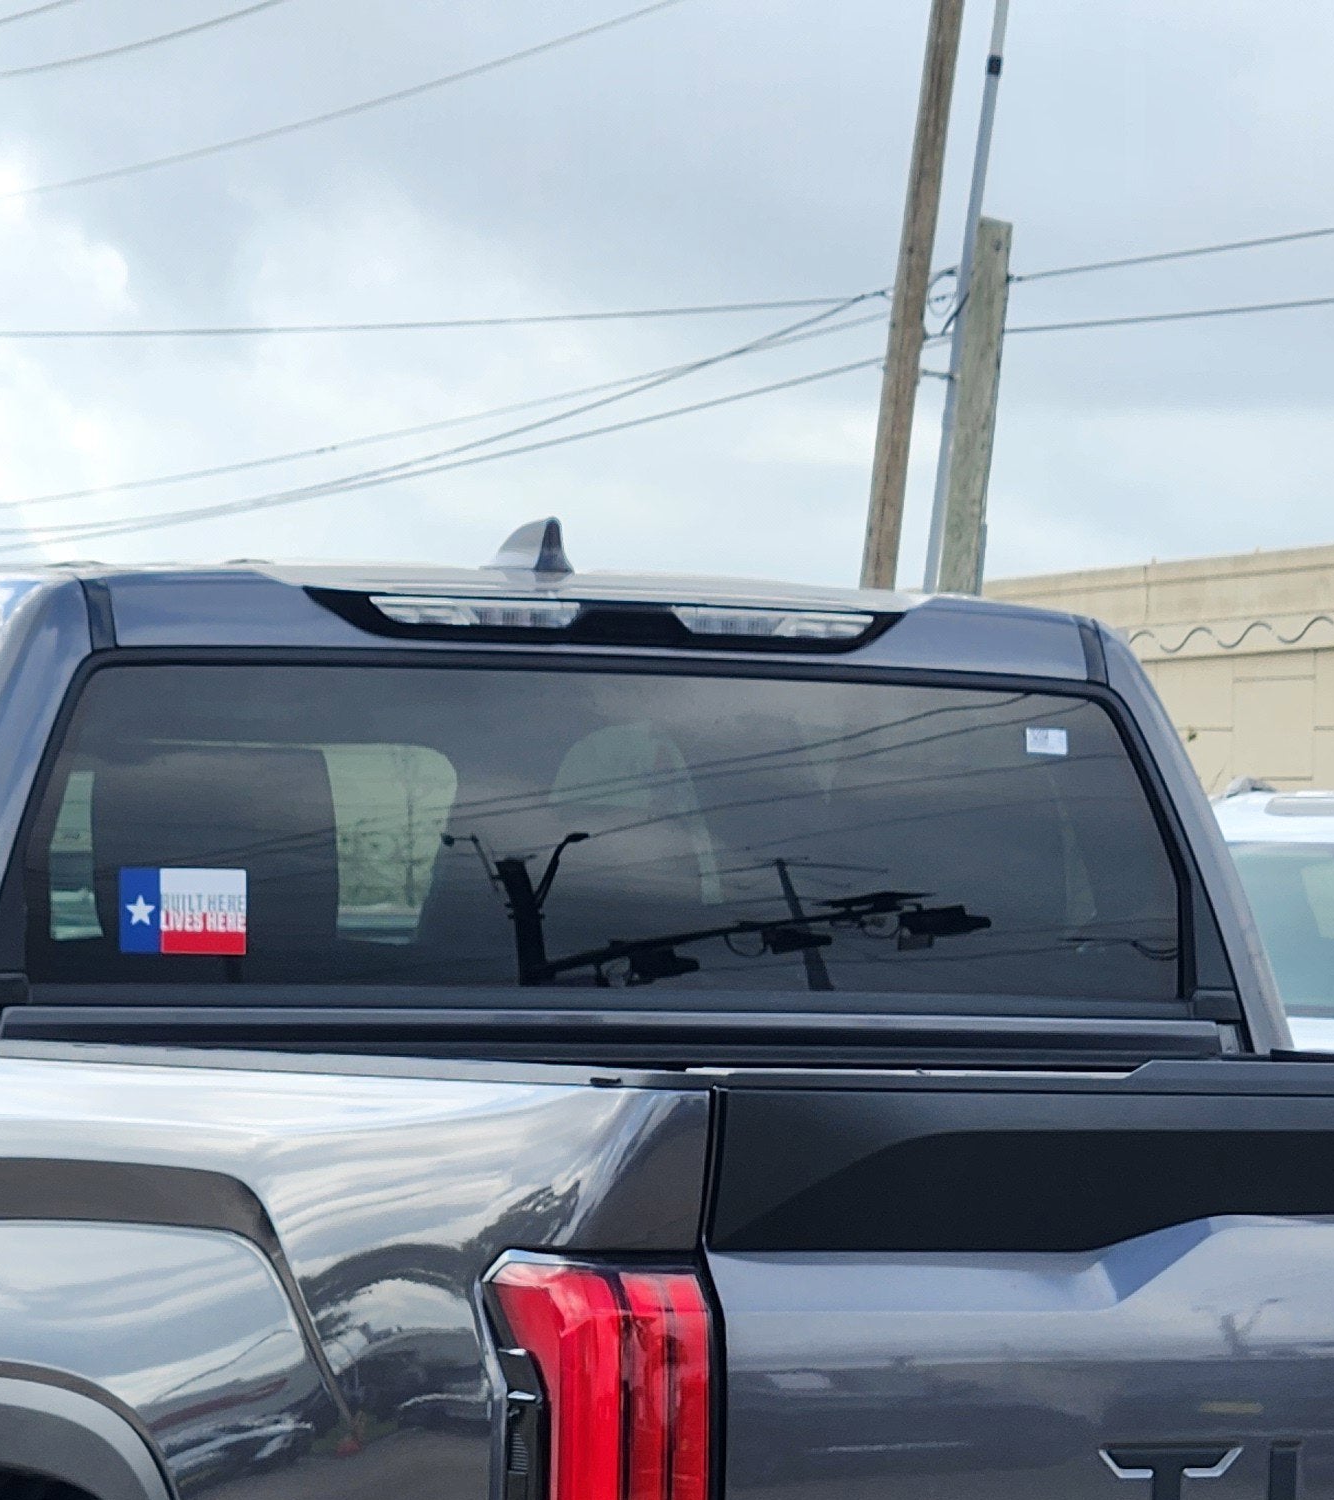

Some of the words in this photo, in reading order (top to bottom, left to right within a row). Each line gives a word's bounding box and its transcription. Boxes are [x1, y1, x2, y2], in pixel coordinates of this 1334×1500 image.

[161, 893, 203, 911] BUILT
[208, 893, 245, 912] HERE
[161, 910, 203, 932] LIVES
[208, 911, 246, 932] HERE
